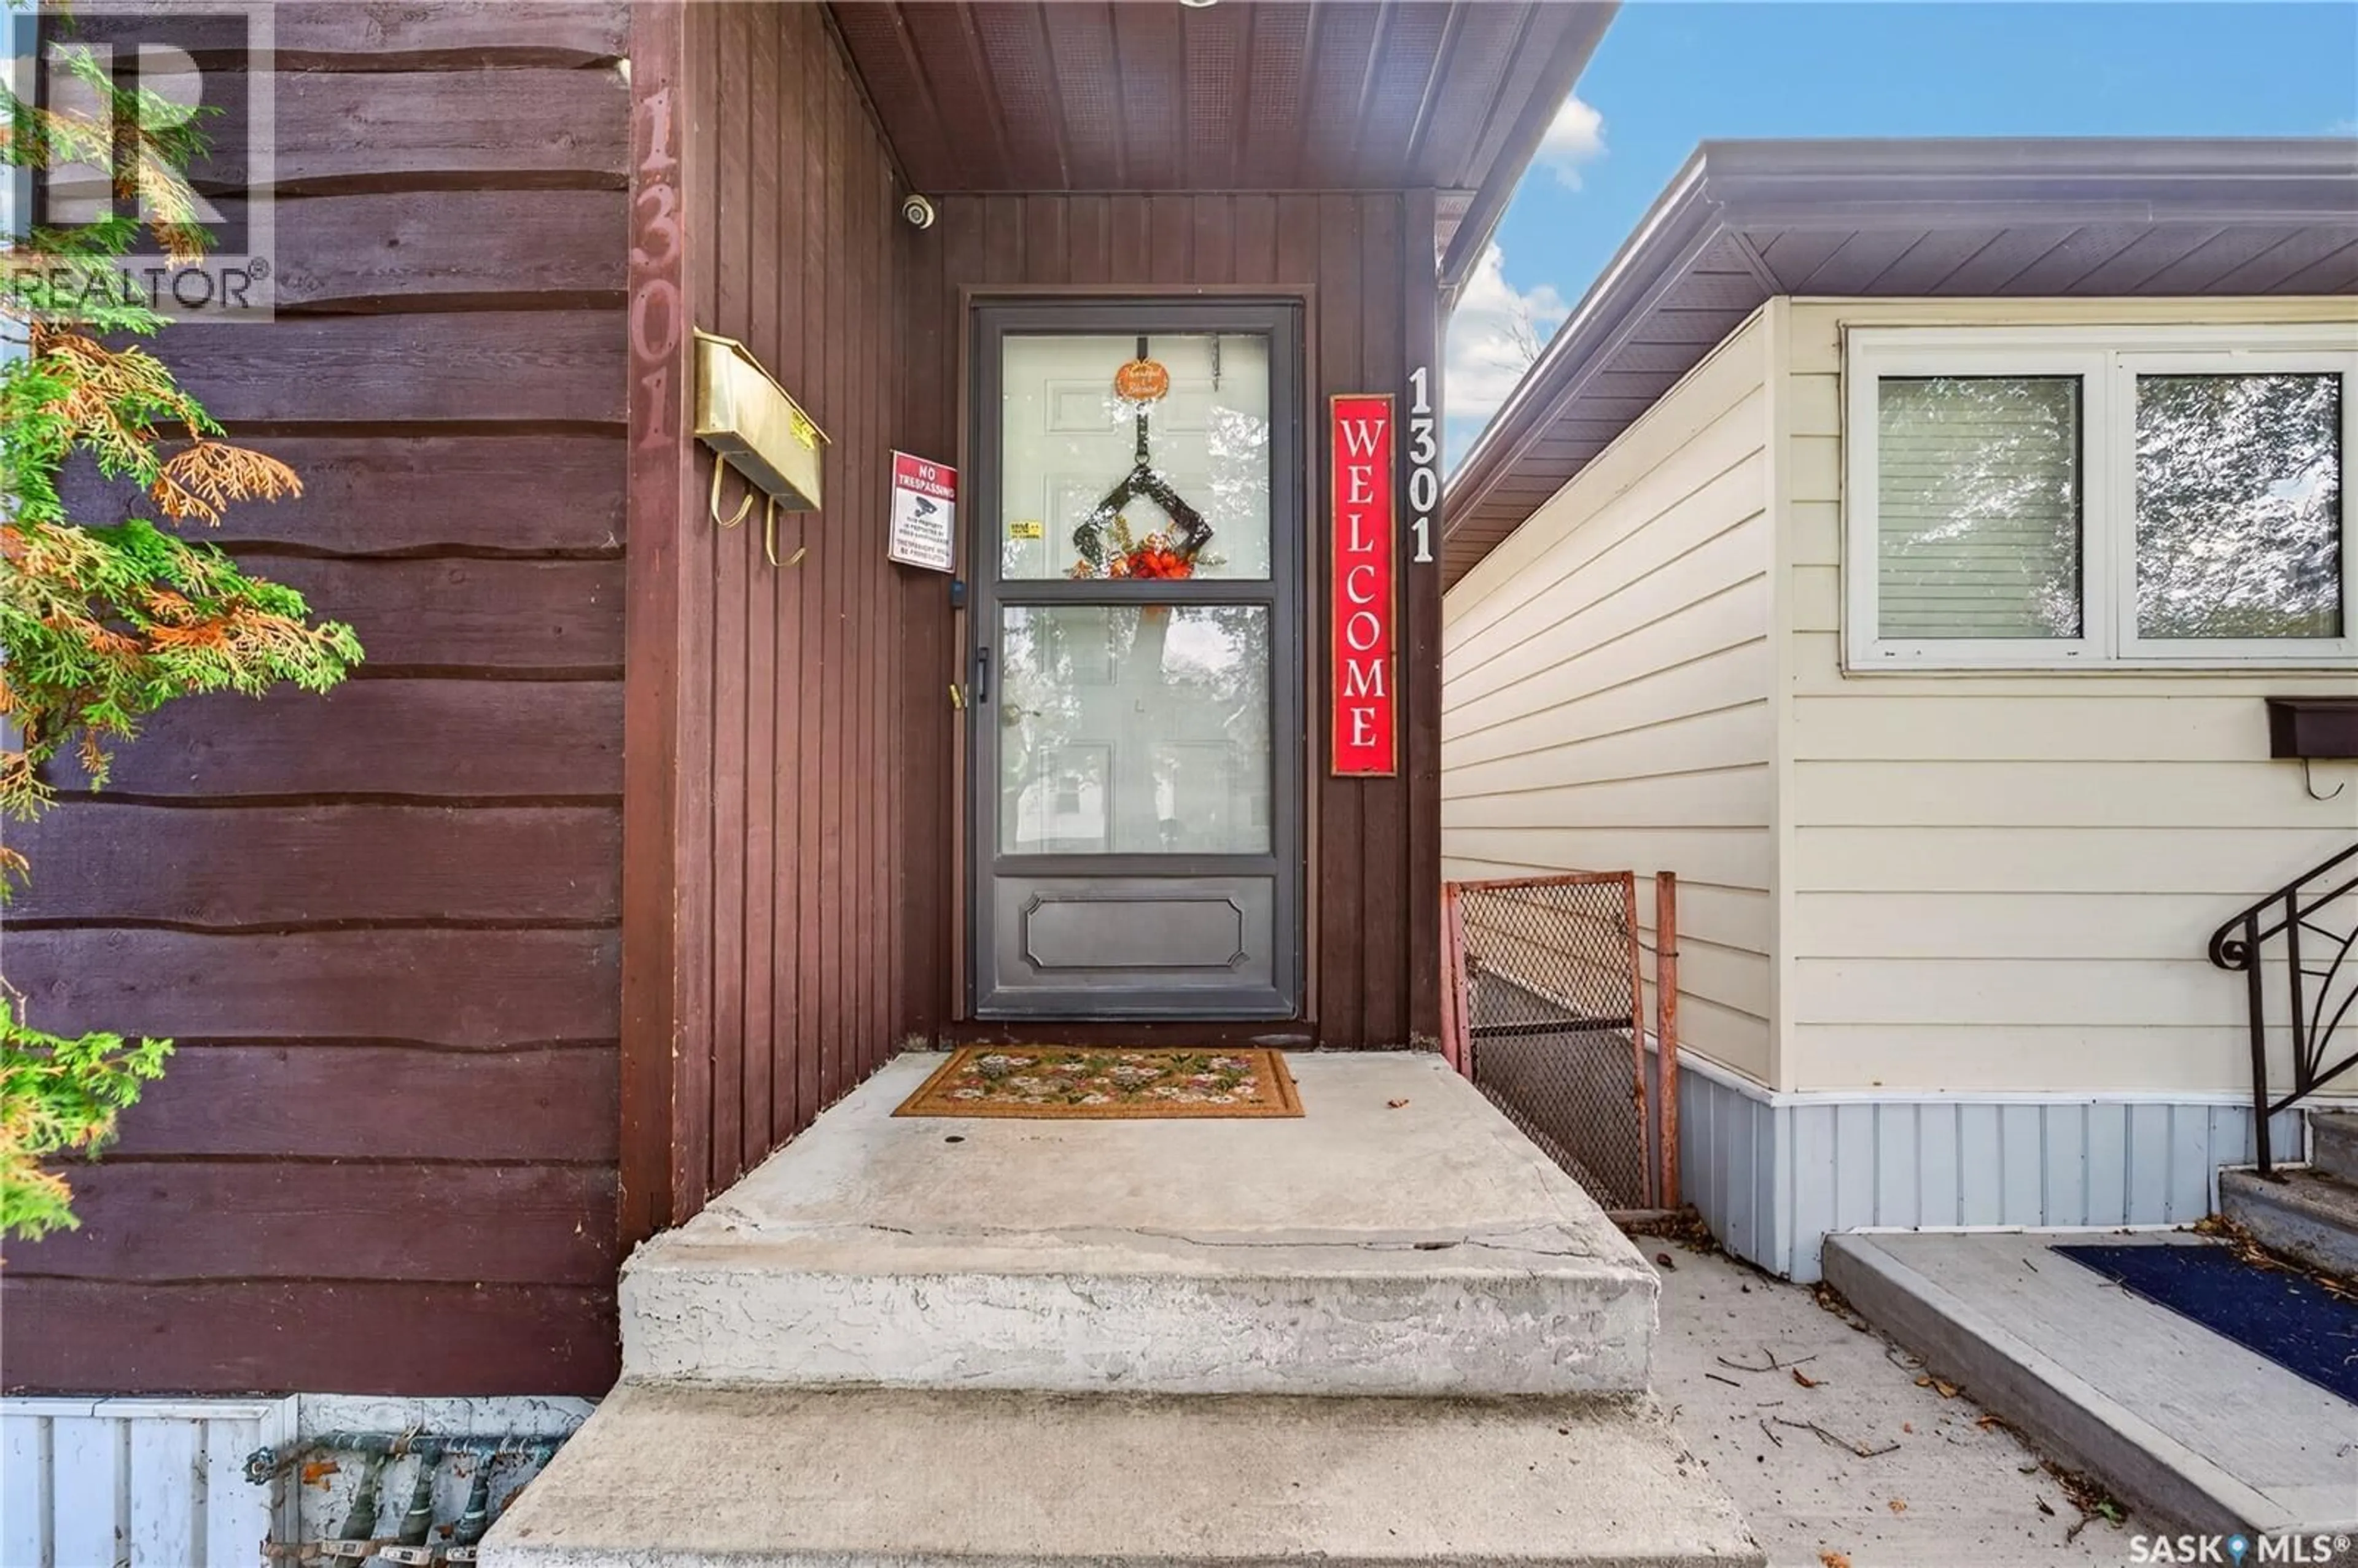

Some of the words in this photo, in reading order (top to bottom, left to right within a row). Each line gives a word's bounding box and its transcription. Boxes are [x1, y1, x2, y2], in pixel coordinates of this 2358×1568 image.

[631, 87, 681, 449] 1301
[898, 474, 955, 499] TRESPASSING
[919, 465, 936, 481] NO
[1409, 367, 1438, 562] 1301
[1340, 419, 1387, 747] WELCOME
